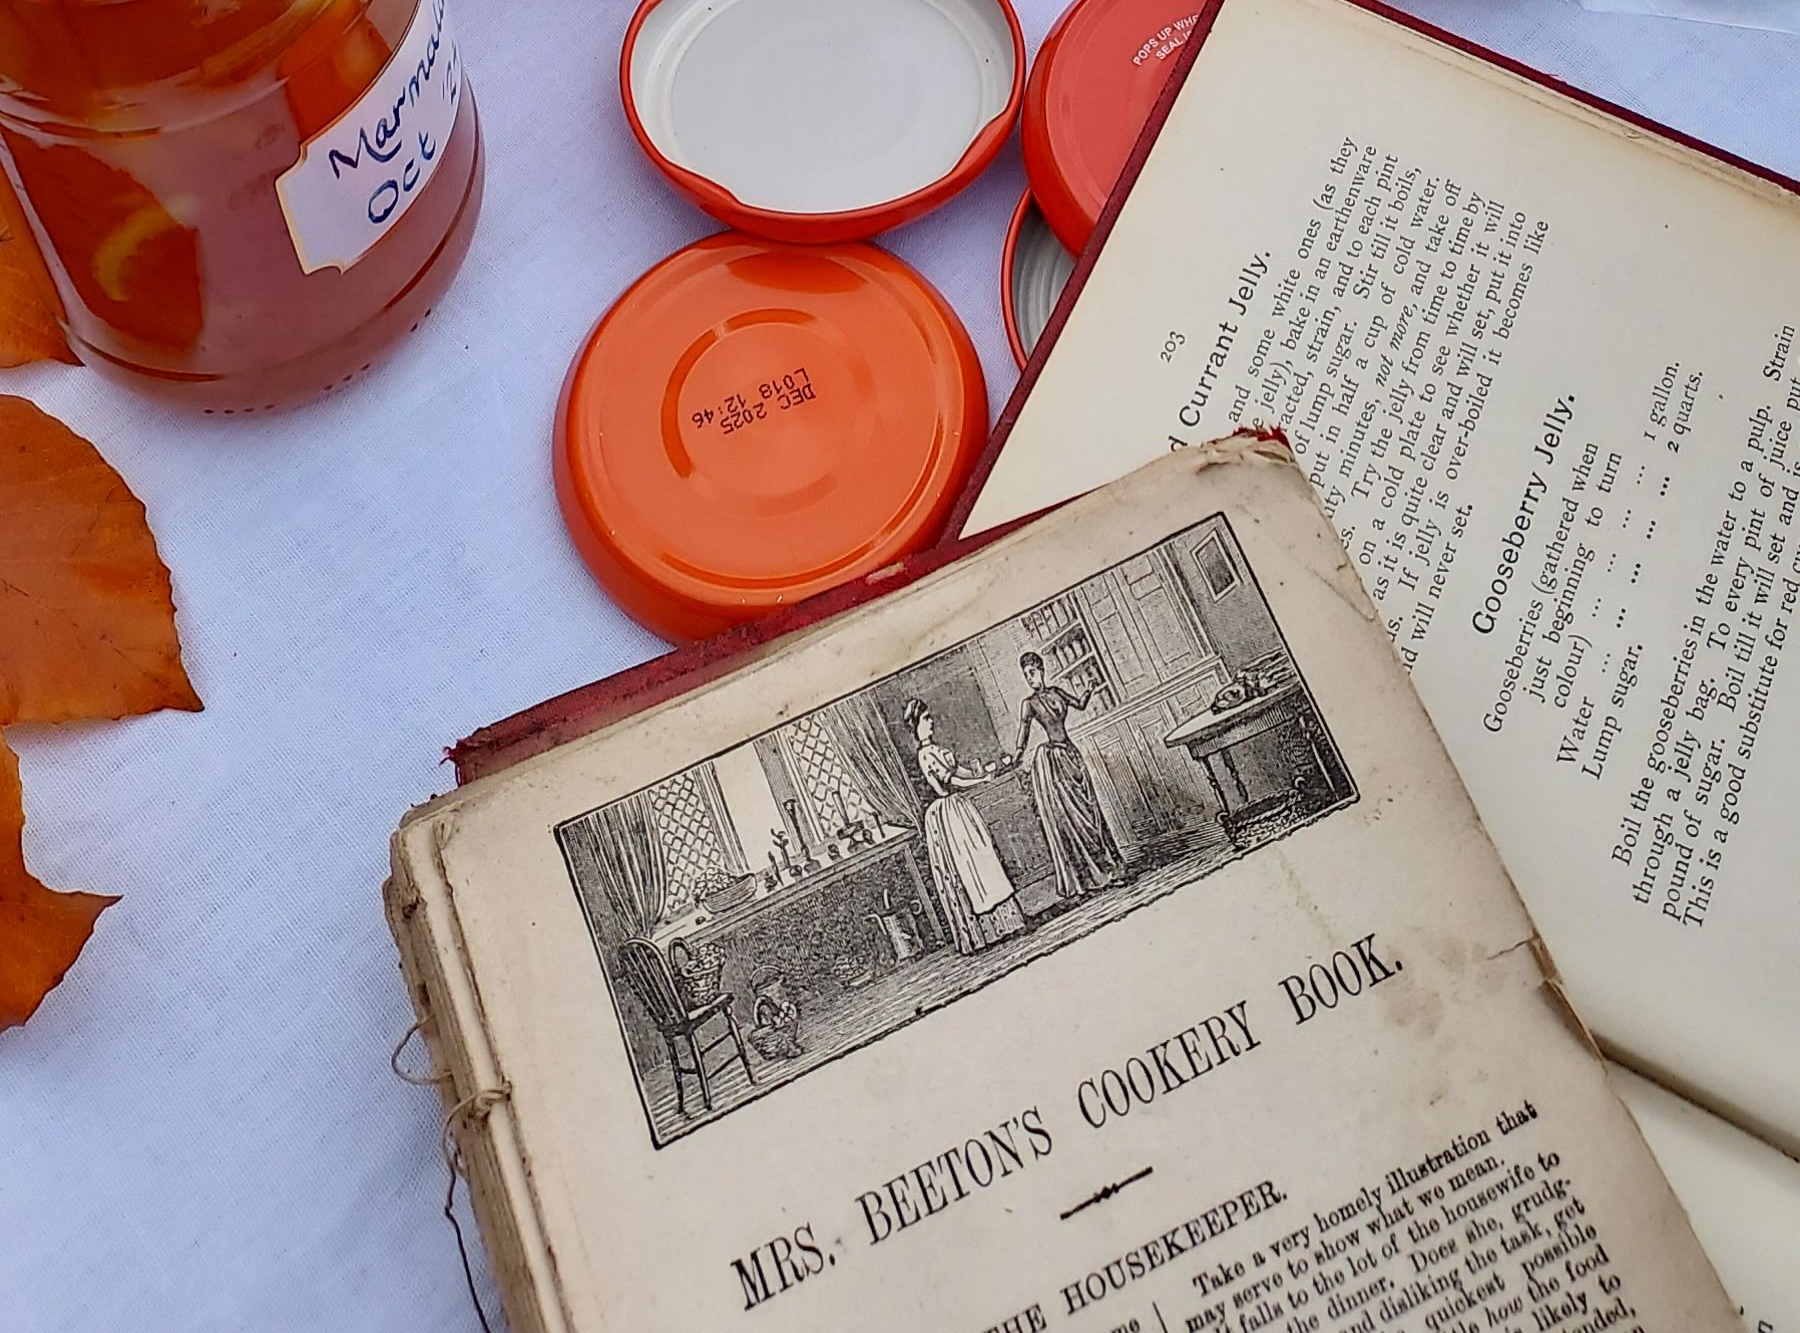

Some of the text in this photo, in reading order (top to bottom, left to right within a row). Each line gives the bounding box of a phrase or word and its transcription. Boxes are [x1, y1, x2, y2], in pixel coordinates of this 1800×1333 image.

[1132, 38, 1159, 66] POPS
[1156, 27, 1172, 41] UP
[1155, 37, 1184, 60] SEAL
[368, 130, 437, 225] Oct
[1228, 136, 1358, 422] and some white ones (as they
[1254, 146, 1376, 414] jelly), bake in an earthenware
[691, 367, 810, 429] L018 12:46
[720, 383, 817, 435] DEC 2025
[1160, 330, 1185, 363] 203
[1178, 251, 1270, 426] Currant Jelly.
[1294, 167, 1421, 454] of lump sugar. Stir till it boils,
[1398, 221, 1548, 591] If jelly is over-boiled it becomes like
[1471, 394, 1575, 633] Gooseberry Jelly.
[1483, 442, 1598, 732] Gooseberries (gathered when
[1522, 452, 1622, 703] just beginning to turn
[1553, 634, 1592, 708] colour)
[1649, 362, 1679, 427] gallon.
[1555, 371, 1703, 762] Water 2 quarts.
[1611, 325, 1795, 866] Boil the gooseberries in the water to a pulp. Strain
[1581, 644, 1643, 780] Lump sugar.
[729, 932, 1403, 1311] MRS. BEETON'S COOKERY BOOK.
[1191, 1101, 1538, 1298] Take a very homely illustration that
[1059, 1180, 1287, 1316] HOUSEKEEPER.
[1184, 1155, 1504, 1333] may serve to show what we mean.
